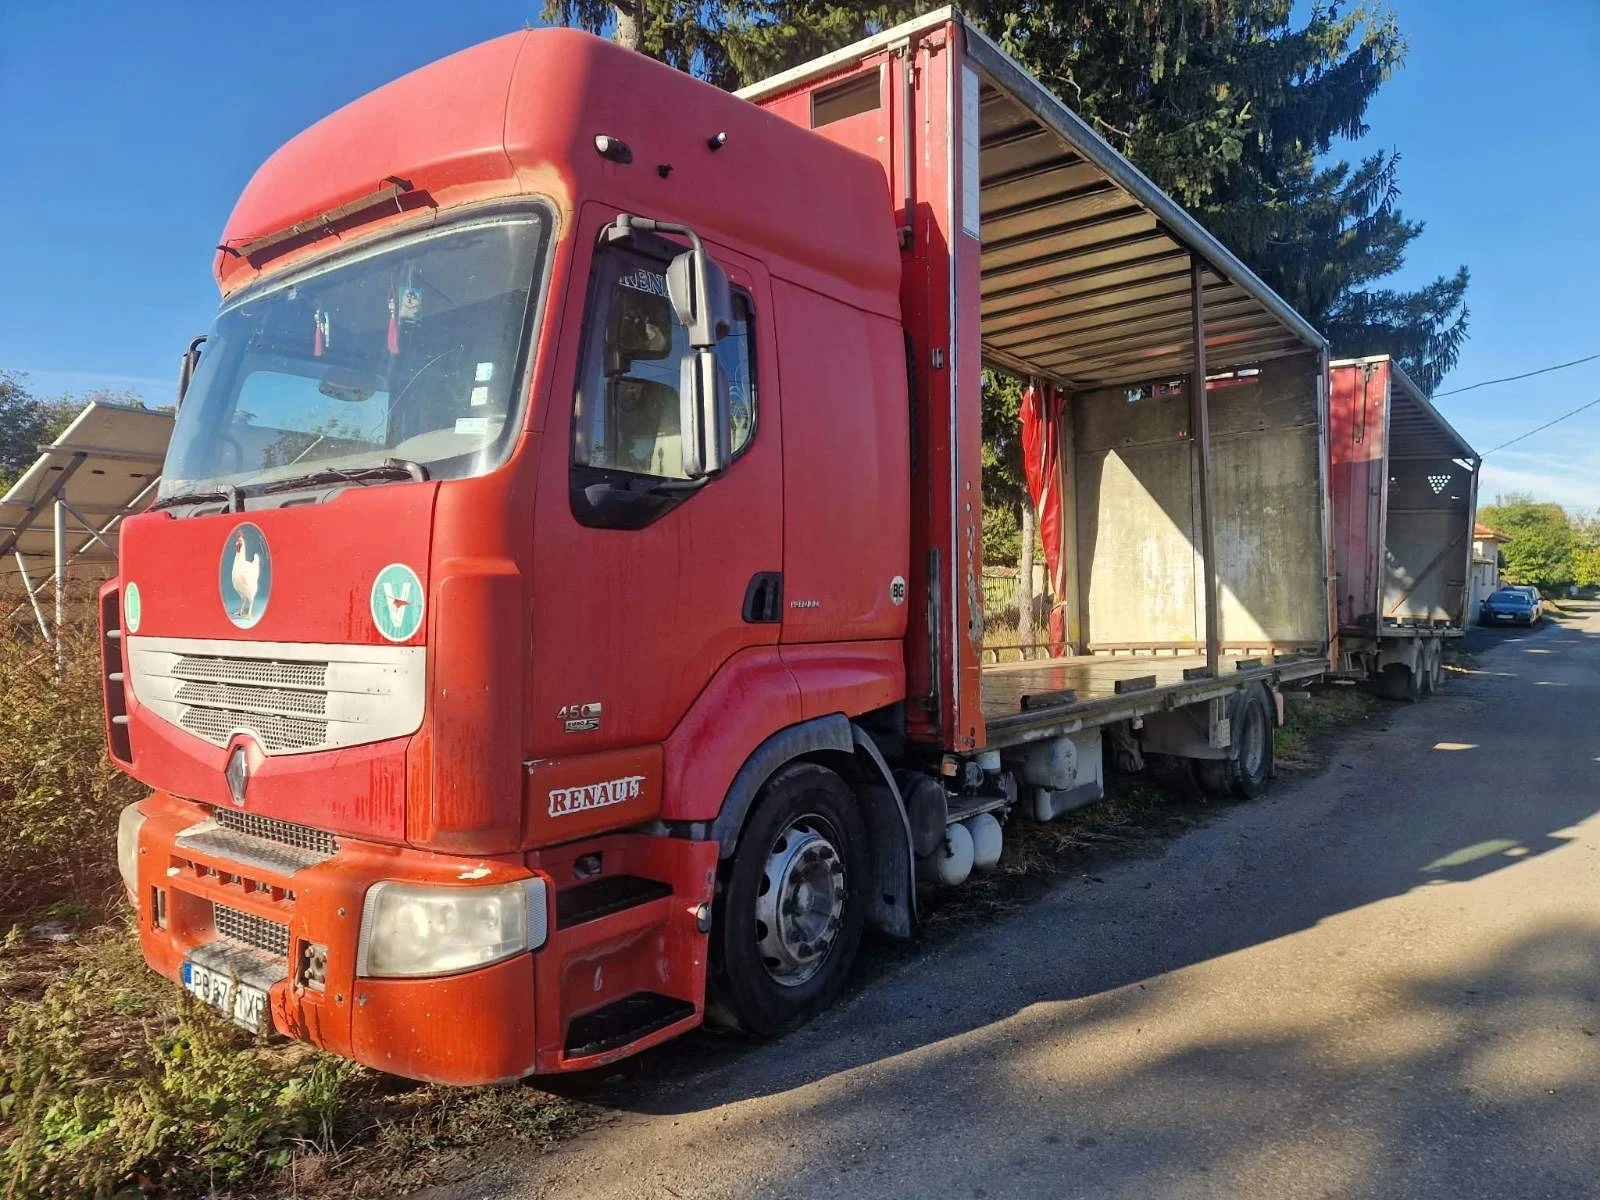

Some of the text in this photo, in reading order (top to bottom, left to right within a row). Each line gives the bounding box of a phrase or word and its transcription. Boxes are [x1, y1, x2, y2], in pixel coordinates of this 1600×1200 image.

[892, 583, 904, 598] BG
[382, 582, 412, 628] V
[556, 703, 591, 719] 450
